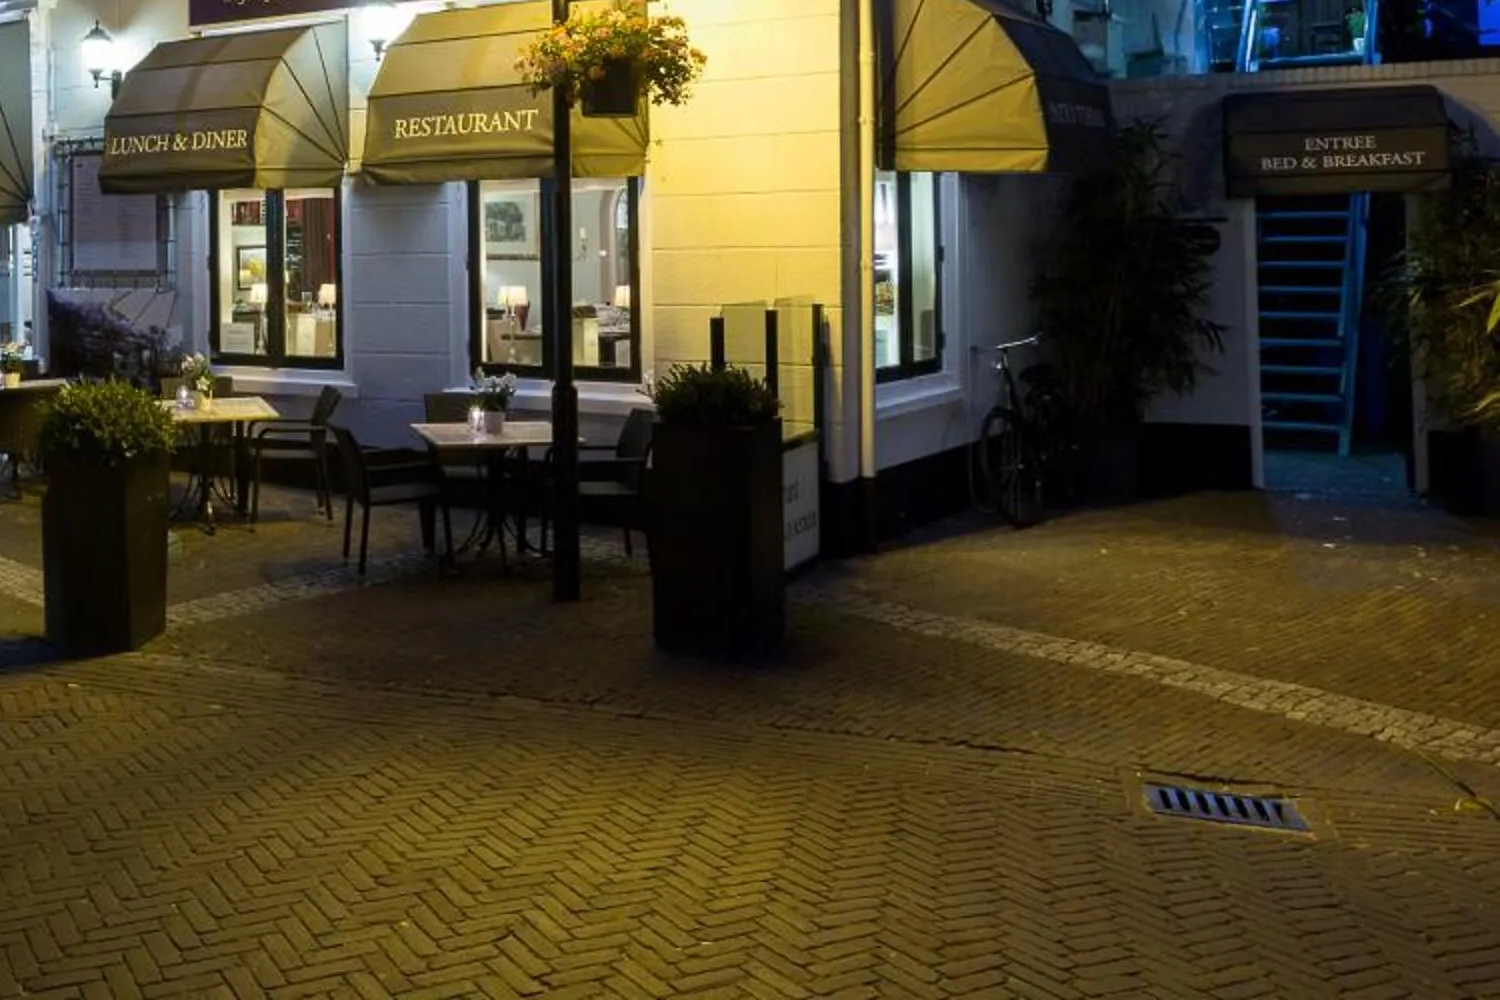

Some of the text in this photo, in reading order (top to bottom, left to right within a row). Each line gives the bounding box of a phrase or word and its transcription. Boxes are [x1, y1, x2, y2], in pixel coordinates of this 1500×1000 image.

[394, 109, 539, 140] RESTAURANT
[109, 129, 248, 156] LUNCH & DINER
[1304, 135, 1377, 151] ENTREE
[1260, 151, 1426, 171] BED & BREAKFAST
